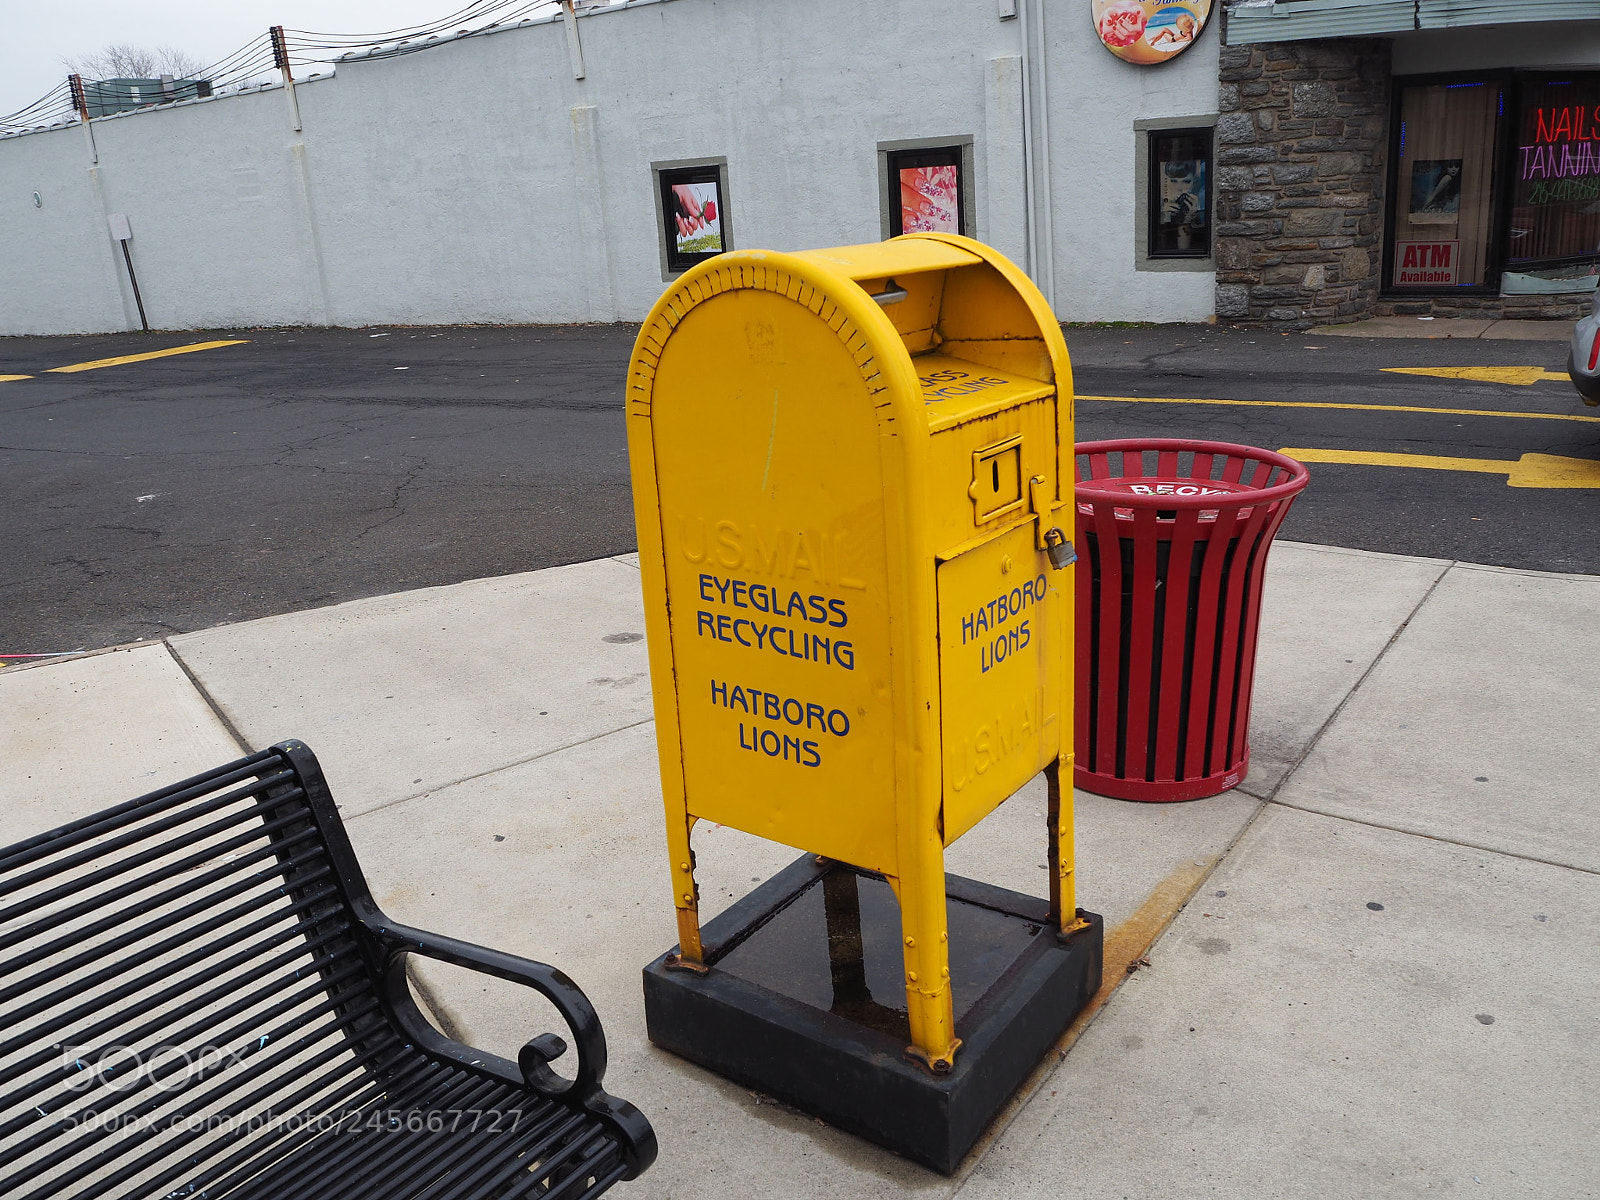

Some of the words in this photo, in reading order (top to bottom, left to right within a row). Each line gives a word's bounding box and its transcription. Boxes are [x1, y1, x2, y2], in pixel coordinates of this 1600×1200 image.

[1400, 271, 1451, 282] Available
[1402, 244, 1451, 267] ATM
[699, 573, 848, 627] EYEGLASS
[961, 573, 1047, 645] HATBORO
[697, 610, 855, 670] RECYCLING
[981, 620, 1030, 674] LIONS
[711, 679, 850, 737] HATBORO
[739, 723, 821, 768] LIONS
